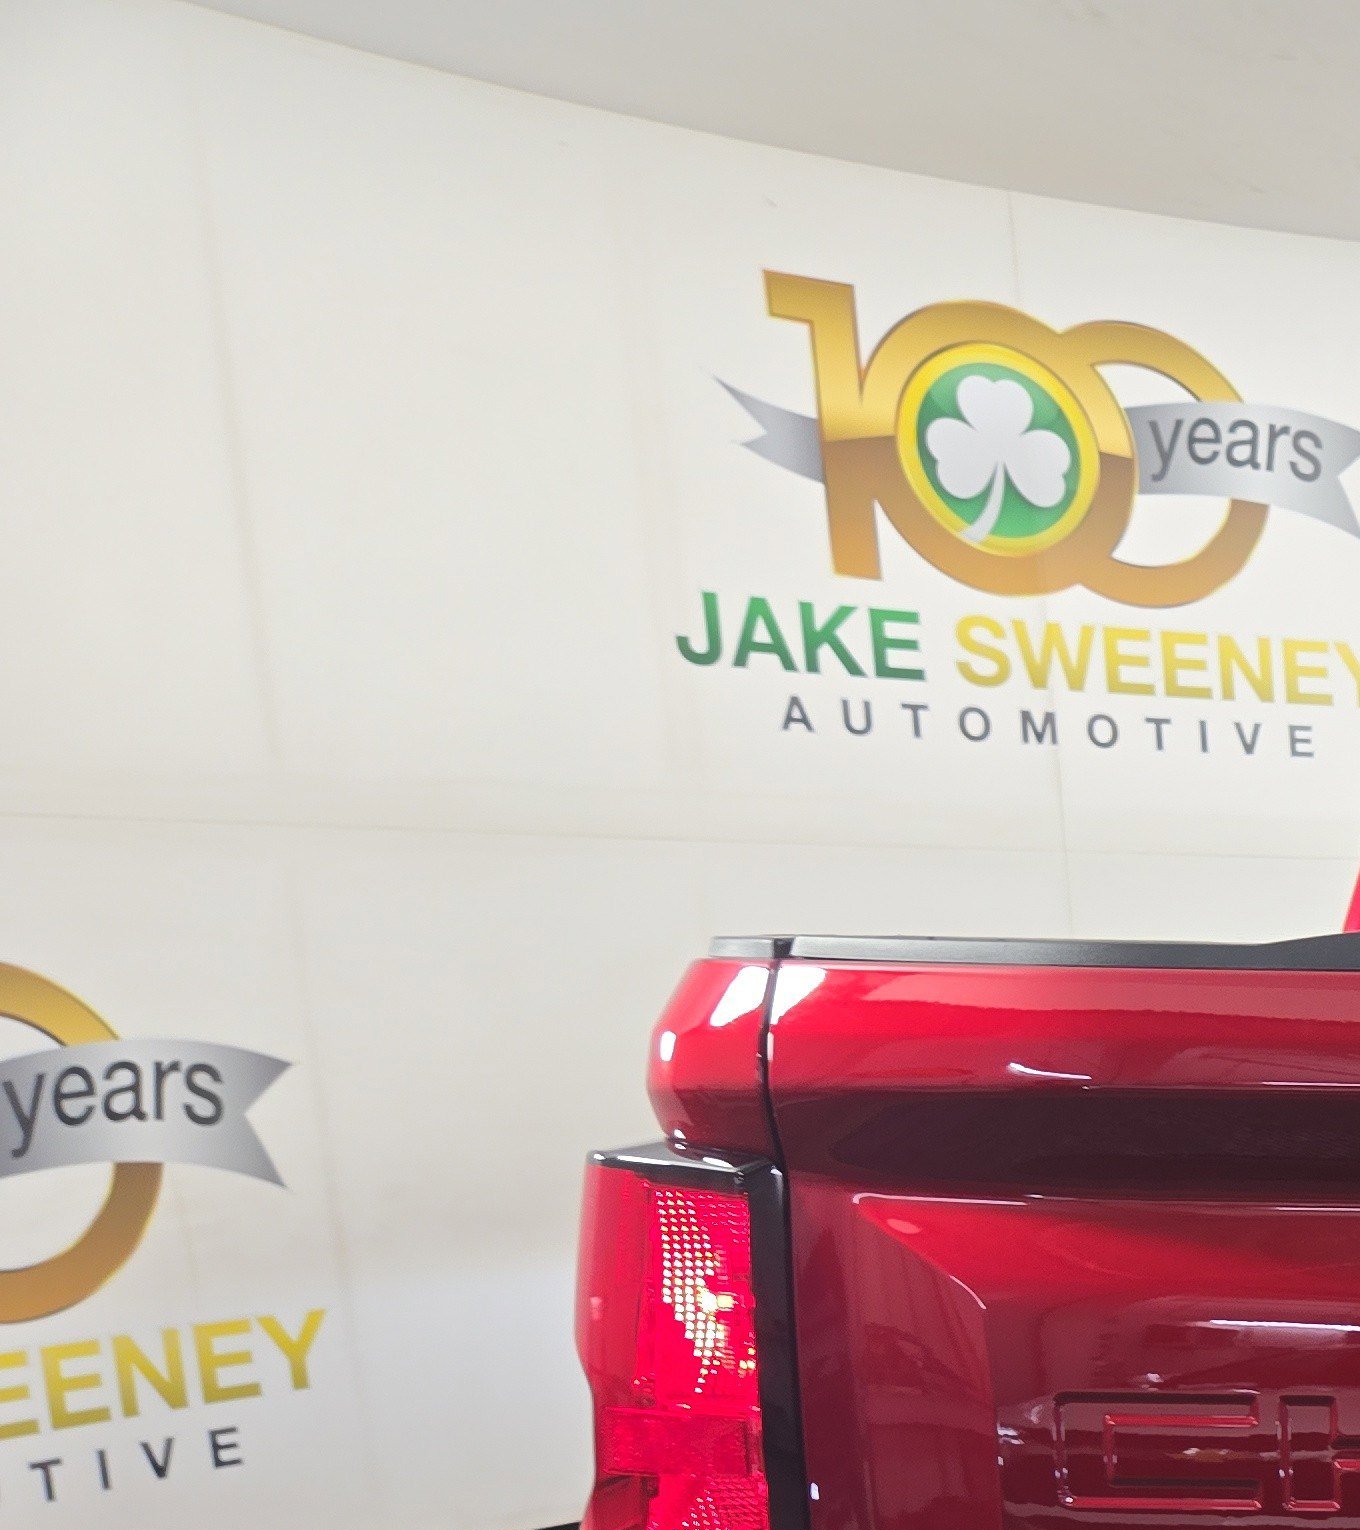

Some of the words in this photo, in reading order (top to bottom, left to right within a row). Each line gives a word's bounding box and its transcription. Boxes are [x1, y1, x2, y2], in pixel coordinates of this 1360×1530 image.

[1147, 413, 1323, 483] years
[676, 590, 927, 683] JAKE
[782, 696, 1316, 758] AUTOMOTIVE
[2, 1058, 225, 1159] years
[27, 1426, 244, 1502] TIVE
